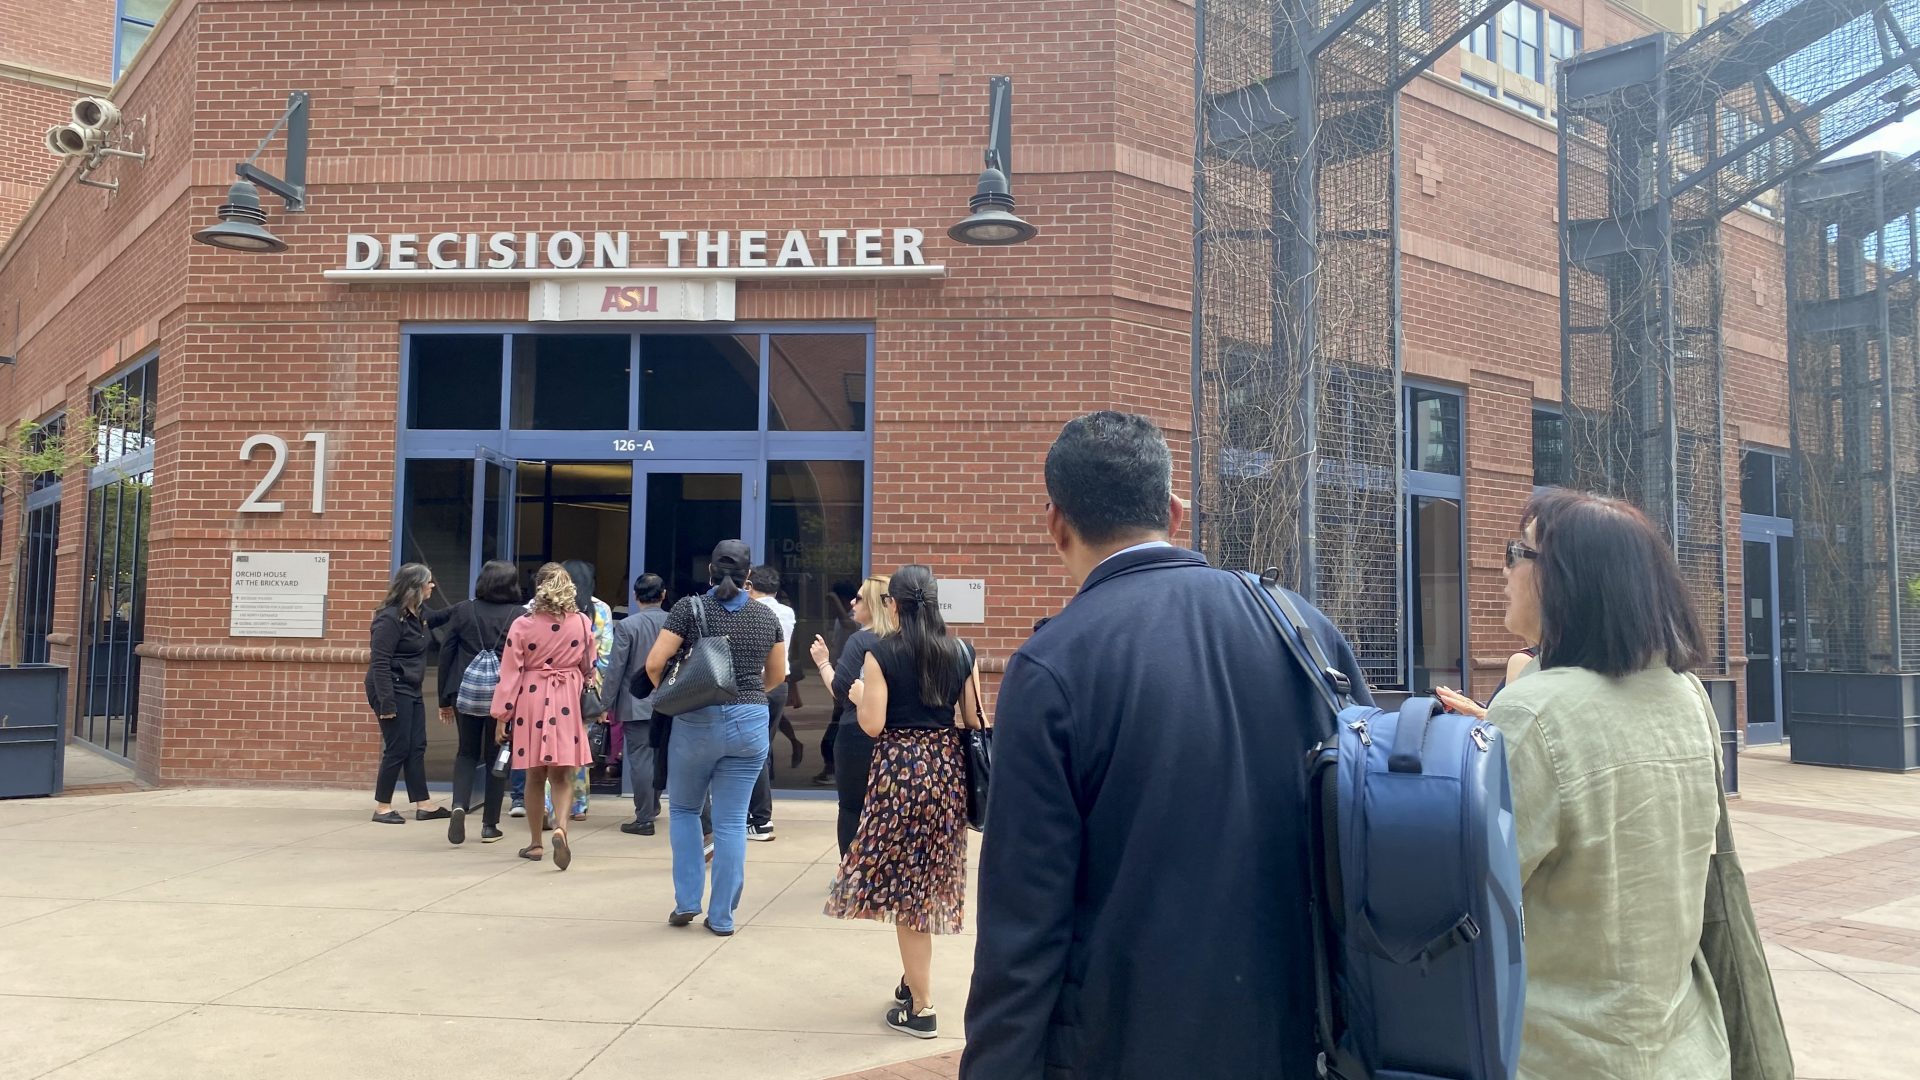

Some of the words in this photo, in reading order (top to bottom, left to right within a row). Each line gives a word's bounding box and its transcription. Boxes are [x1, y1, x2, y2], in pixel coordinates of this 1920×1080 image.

[346, 230, 630, 270] DECISION
[659, 228, 925, 267] THEATER
[600, 286, 658, 312] ASU
[613, 439, 655, 451] 126-A
[236, 432, 327, 514] 21
[235, 579, 244, 587] AT
[245, 579, 259, 587] THE
[898, 1009, 908, 1024] N
